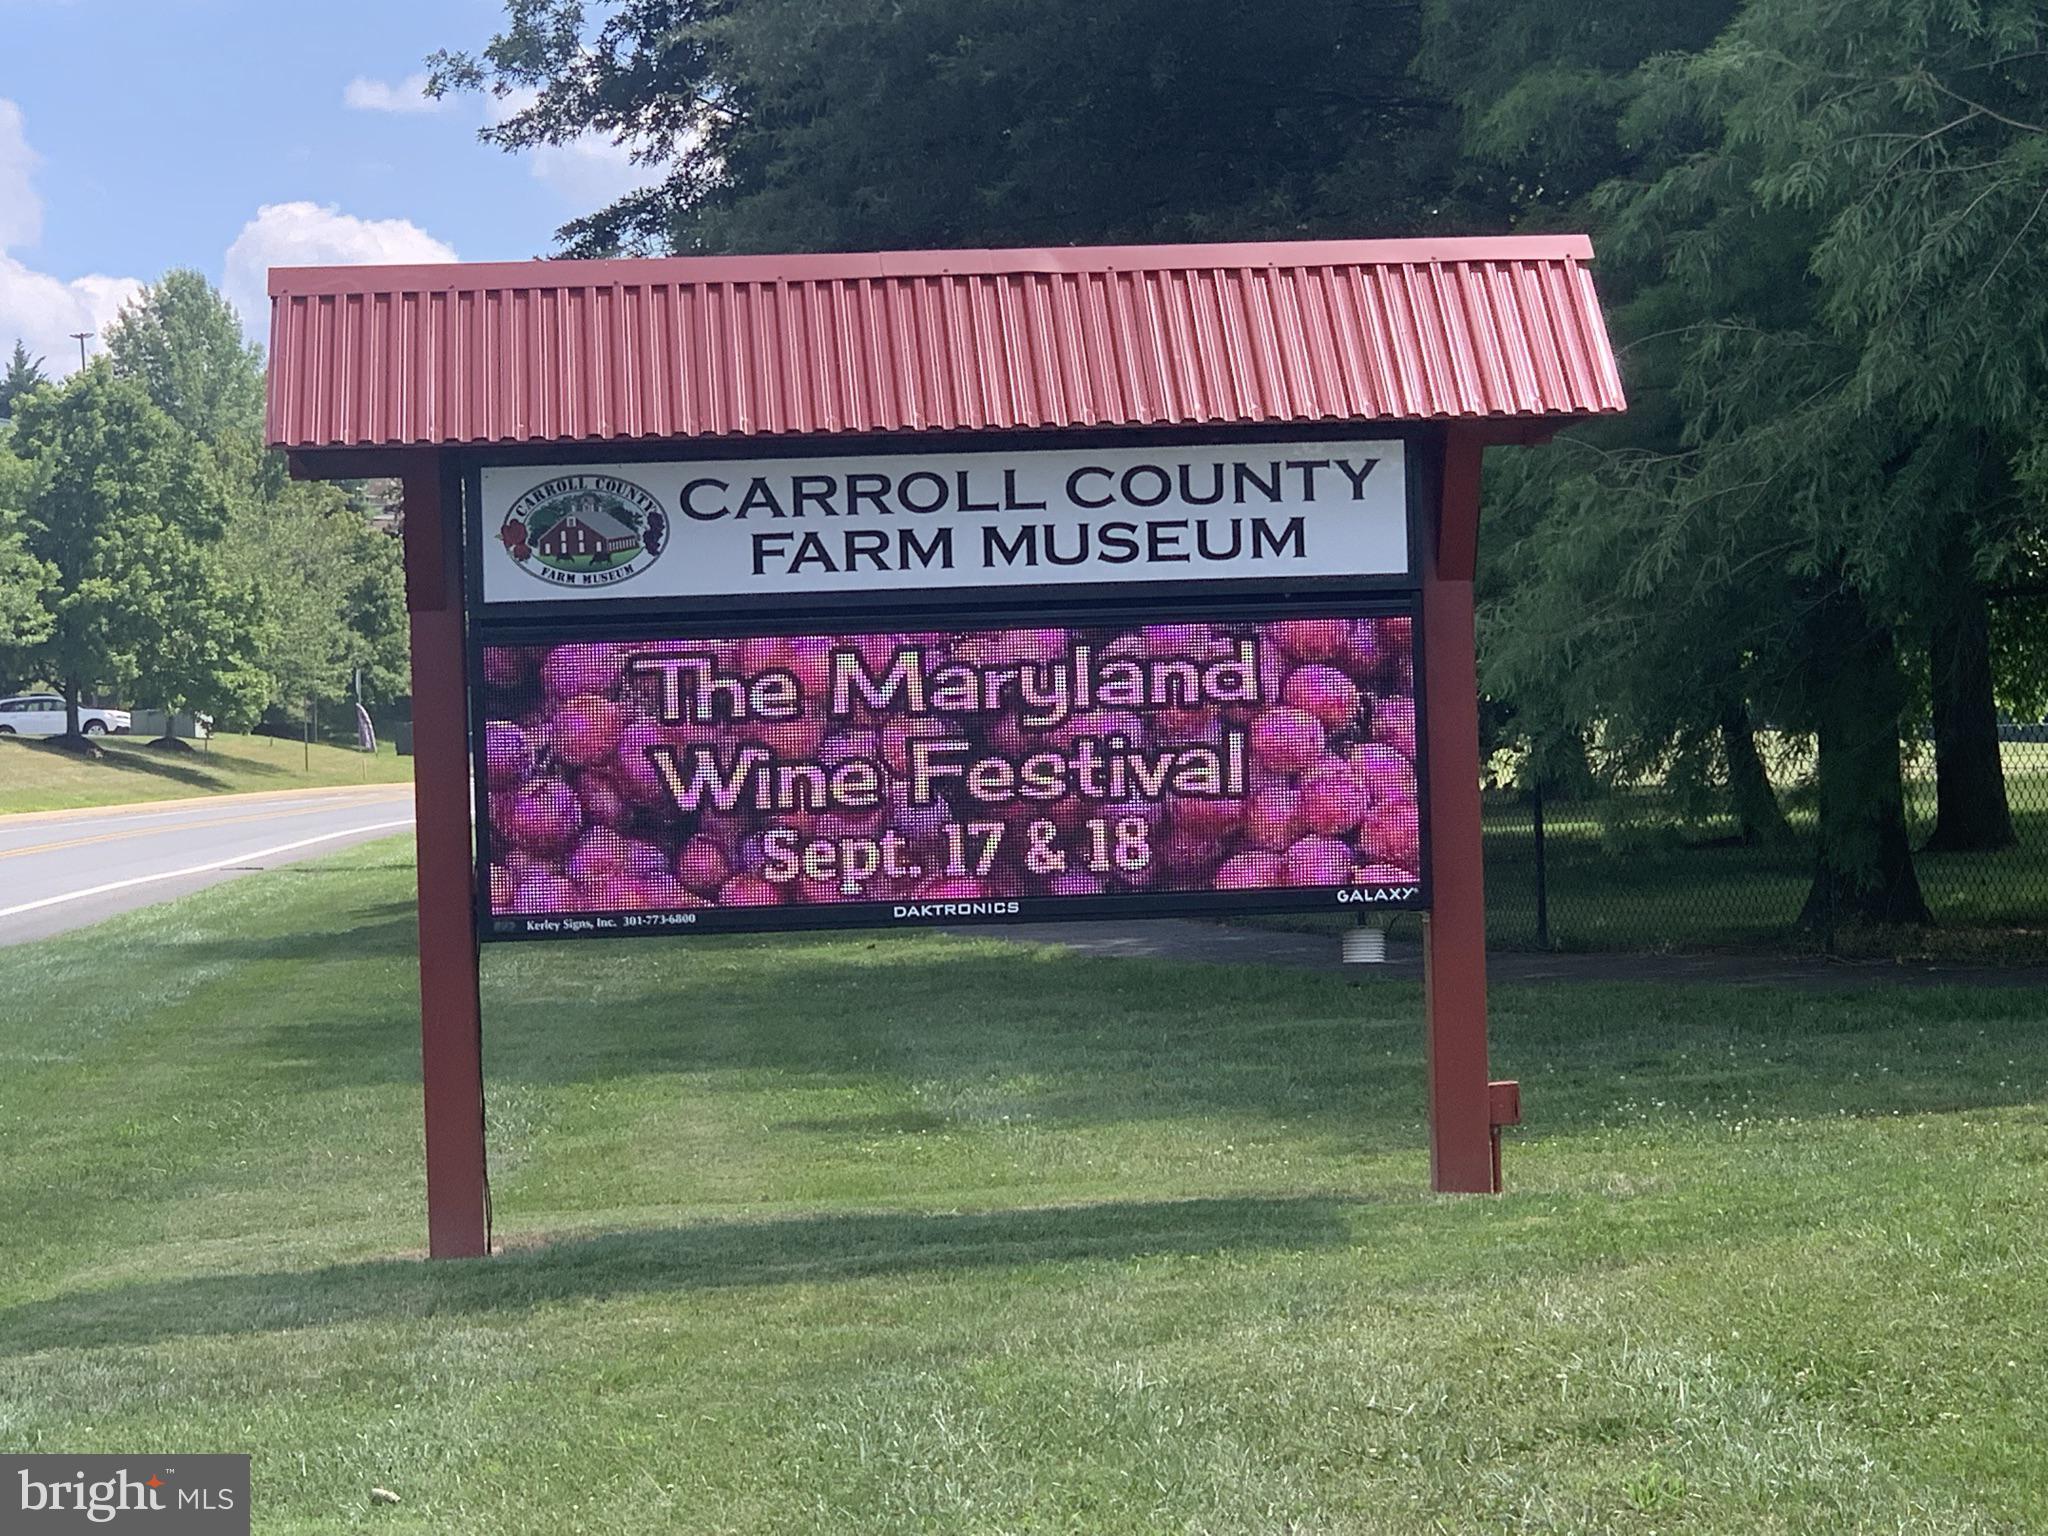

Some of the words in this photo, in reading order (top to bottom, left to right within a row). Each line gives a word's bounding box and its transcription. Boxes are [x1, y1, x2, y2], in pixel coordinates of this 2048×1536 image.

[515, 477, 588, 516] CARROLL
[595, 478, 658, 514] COUNTY
[680, 469, 1047, 521] CARROLL
[1065, 458, 1381, 509] COUNTY
[541, 567, 575, 584] FARM
[582, 563, 634, 584] MUSEUM
[751, 528, 954, 576] FARM
[982, 516, 1307, 568] MUSEUM
[632, 658, 798, 720] The
[833, 640, 1258, 727] Maryland
[652, 746, 877, 810] Wine
[915, 731, 1243, 803] Festival
[762, 830, 922, 895] Sept.
[942, 822, 1005, 877] 17
[1025, 819, 1066, 874] &
[1085, 817, 1152, 872] 18
[526, 920, 561, 932] Kerley
[563, 918, 594, 931] Signs,
[597, 917, 617, 928] Inc.
[623, 913, 697, 927] 301-773-6800
[893, 902, 1020, 919] DAKTRONICS
